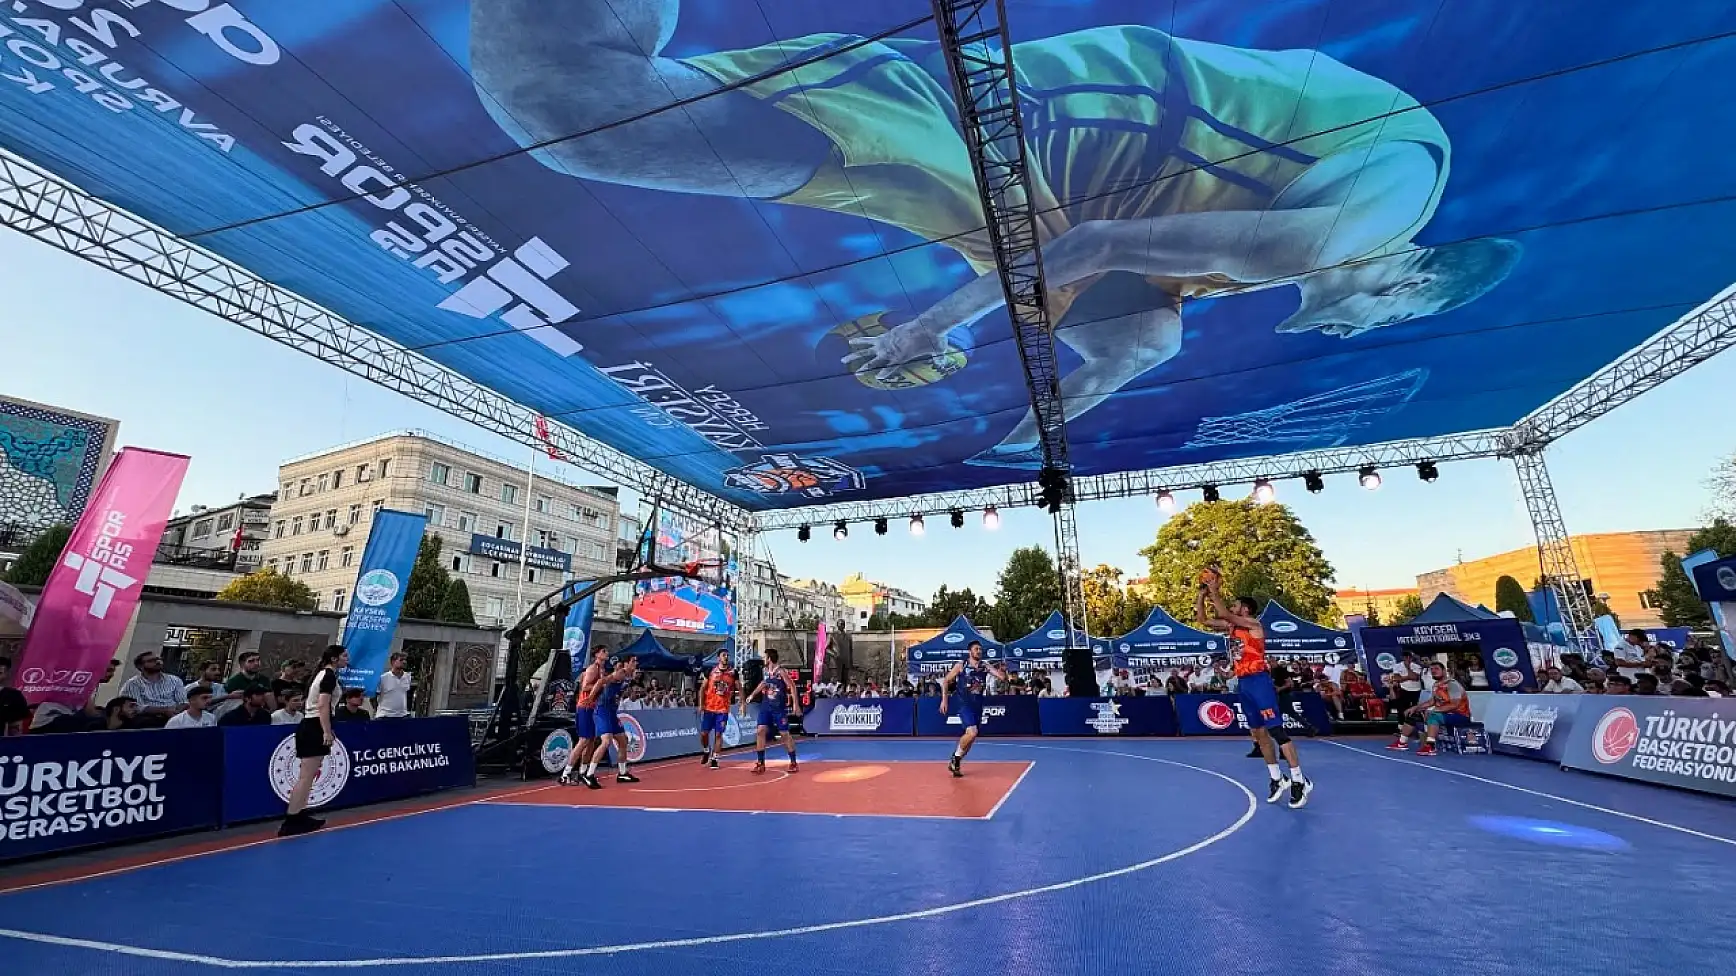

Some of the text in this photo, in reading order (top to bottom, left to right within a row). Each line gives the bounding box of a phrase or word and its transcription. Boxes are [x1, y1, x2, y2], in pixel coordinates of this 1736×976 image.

[91, 510, 126, 562] SPOR
[1127, 656, 1167, 667] ATHLETE
[1169, 655, 1197, 667] ROOM
[1645, 710, 1736, 745] TÜRKİY
[353, 742, 441, 762] T.C. GENÇLİK VE
[354, 754, 449, 778] SPOR BAKANLIĞI
[0, 750, 167, 795] ÜRKİYE
